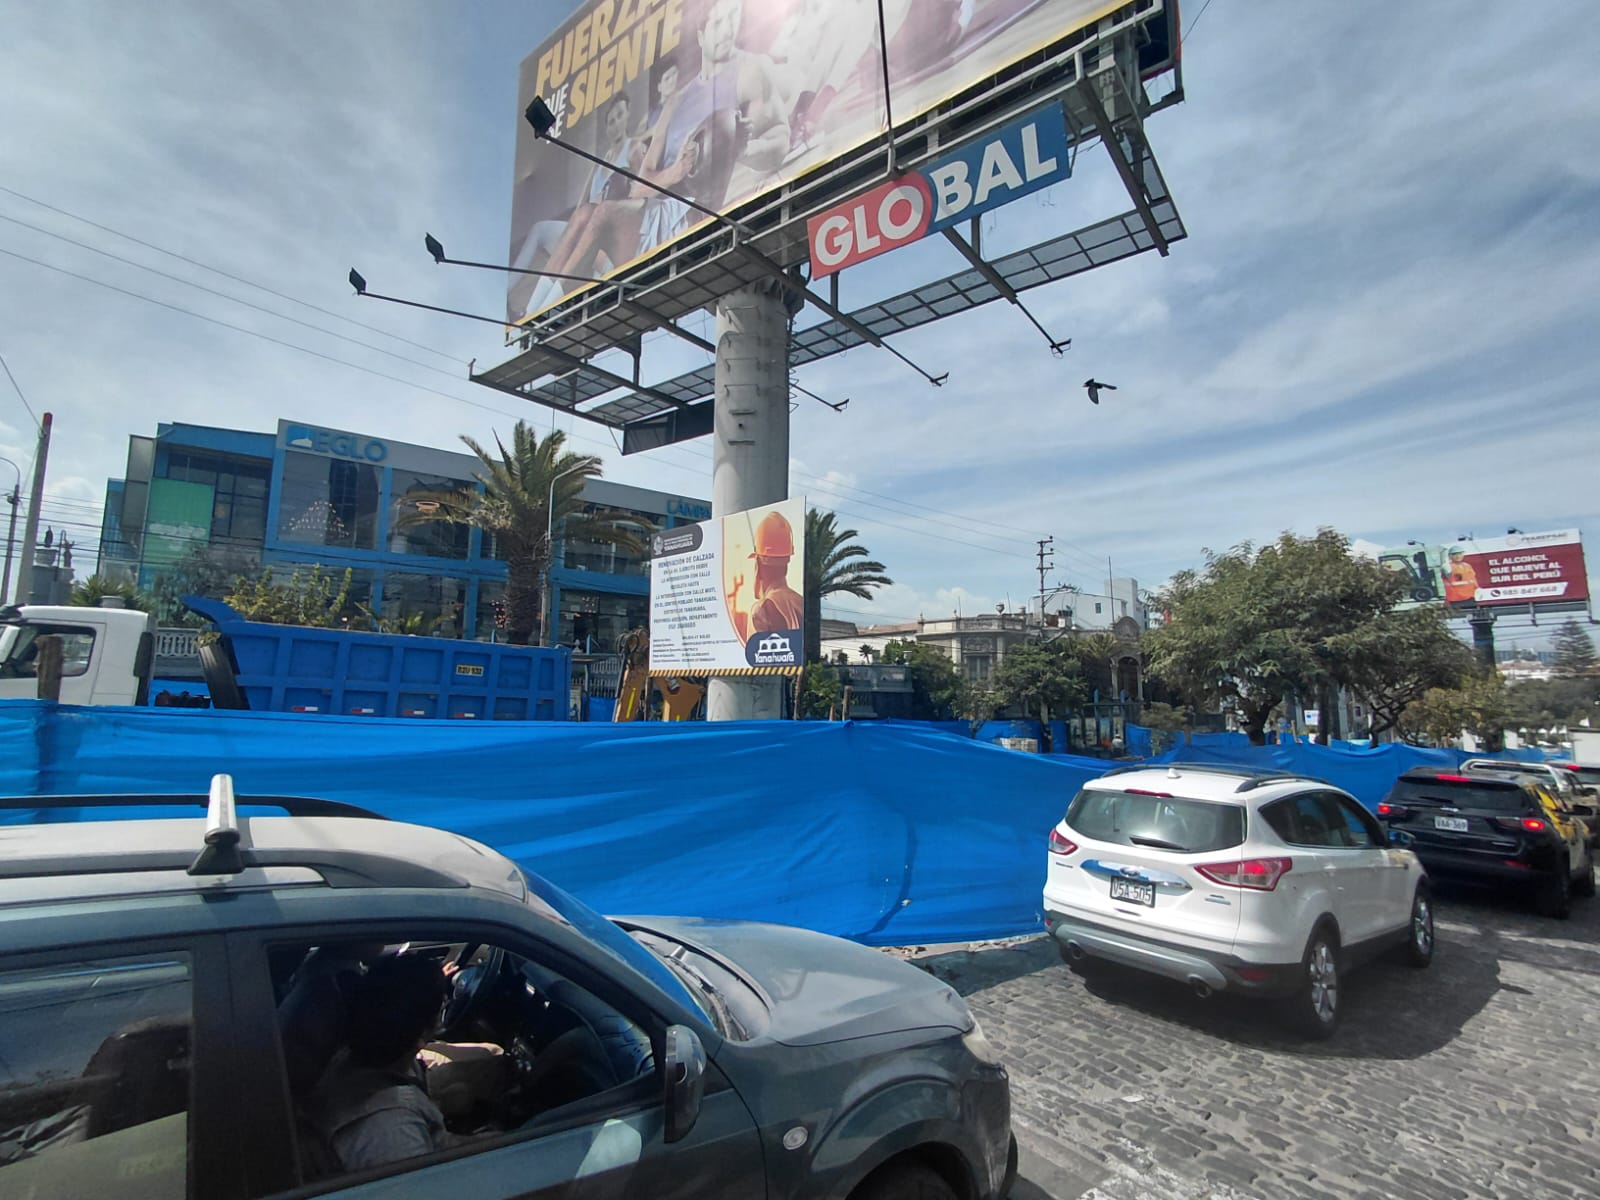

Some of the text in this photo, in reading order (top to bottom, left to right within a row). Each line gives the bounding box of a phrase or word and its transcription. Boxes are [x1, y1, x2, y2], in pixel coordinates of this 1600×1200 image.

[566, 0, 684, 128] SIENTE
[815, 122, 1058, 266] GLOBAL
[316, 431, 388, 462] EGLO
[1488, 554, 1549, 566] EL ALCOHOL
[1489, 561, 1562, 574] QUE MUEVE AL
[1490, 569, 1561, 583] SUR DEL PERÚ
[754, 651, 795, 664] Yanahuara
